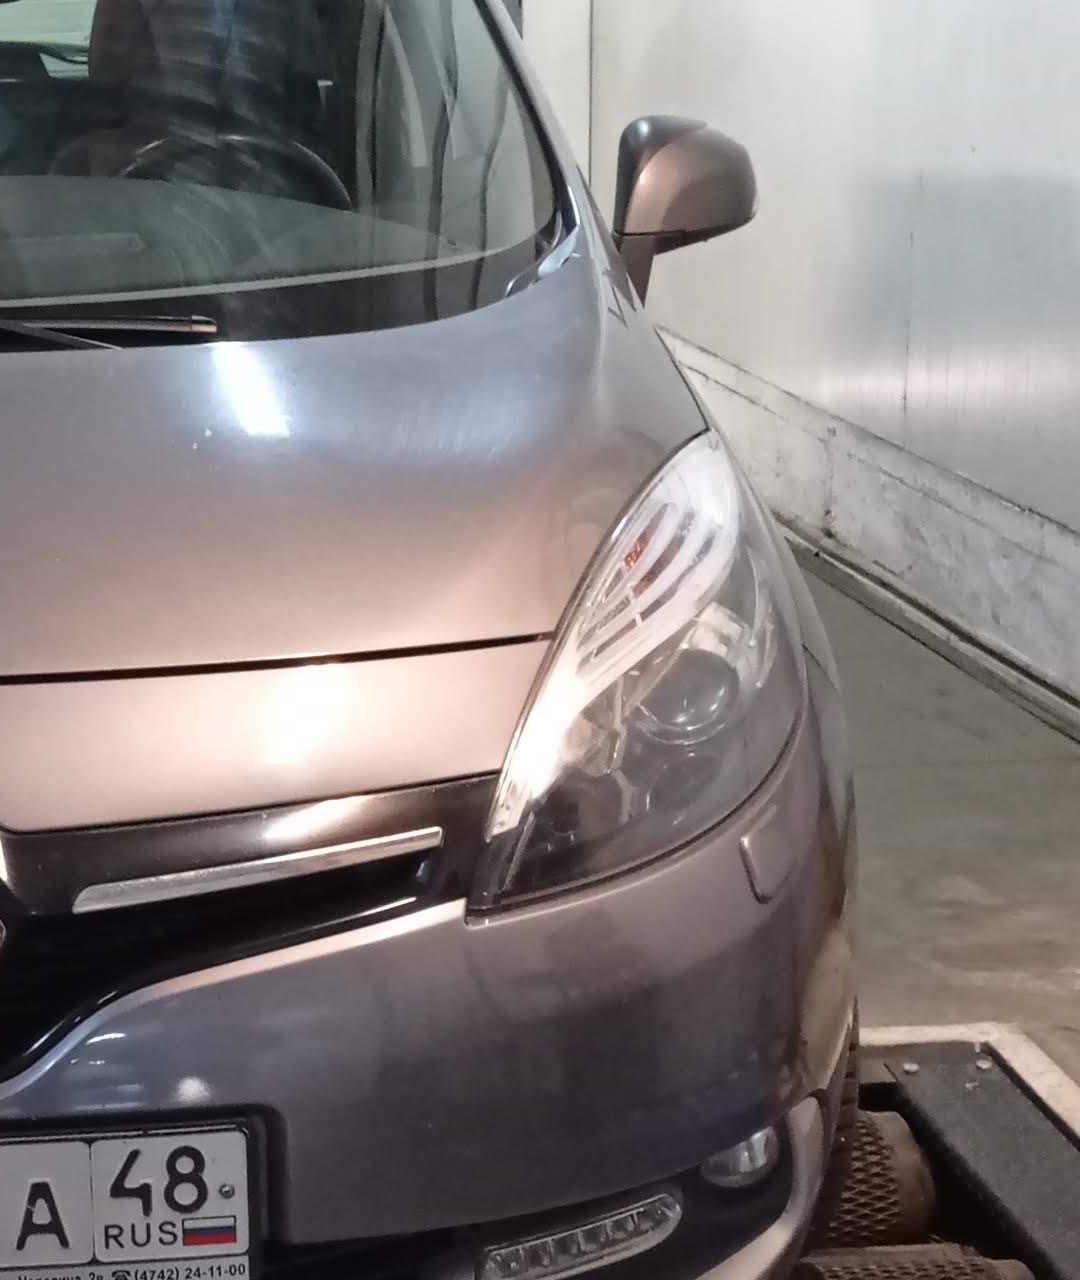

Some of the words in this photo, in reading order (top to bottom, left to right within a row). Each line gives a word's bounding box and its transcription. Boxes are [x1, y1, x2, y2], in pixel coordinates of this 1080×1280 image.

[109, 1145, 210, 1217] 48
[104, 1220, 179, 1250] RUS
[184, 1263, 246, 1280] 24-11-00
